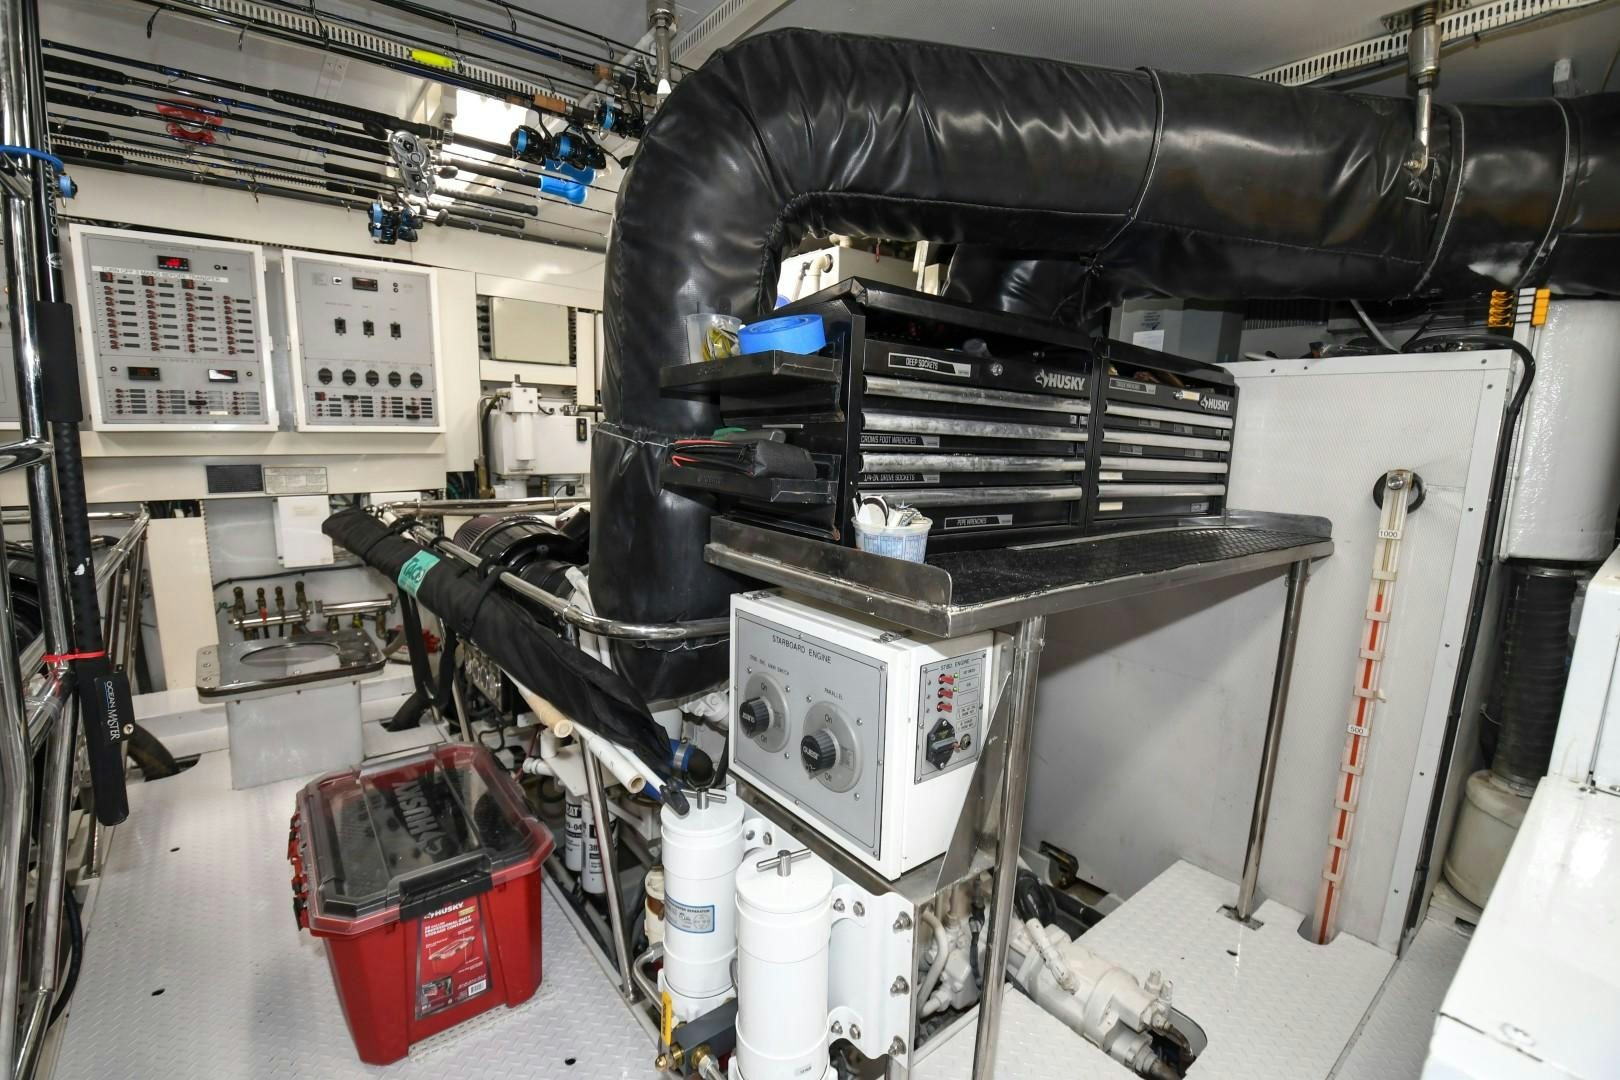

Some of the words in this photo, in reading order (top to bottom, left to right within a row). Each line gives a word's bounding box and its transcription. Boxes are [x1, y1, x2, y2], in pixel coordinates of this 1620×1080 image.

[48, 190, 59, 237] OCEAN
[905, 357, 917, 367] DEEP
[918, 359, 939, 371] SOCKETS
[1049, 373, 1086, 391] HUSKY
[1208, 398, 1231, 411] HUSKY
[880, 436, 891, 444] FOOT
[892, 436, 917, 445] WRENCHES
[880, 473, 894, 482] DRIVE
[895, 473, 915, 482] SOCKETS
[1380, 530, 1397, 538] 1000
[772, 634, 806, 654] STARBOARD
[808, 648, 832, 664] ENGINE
[106, 680, 116, 709] OCEAN
[107, 709, 121, 741] MASTER
[1350, 726, 1364, 734] 500
[392, 781, 440, 835] HUSKY
[434, 901, 464, 916] HUSKY
